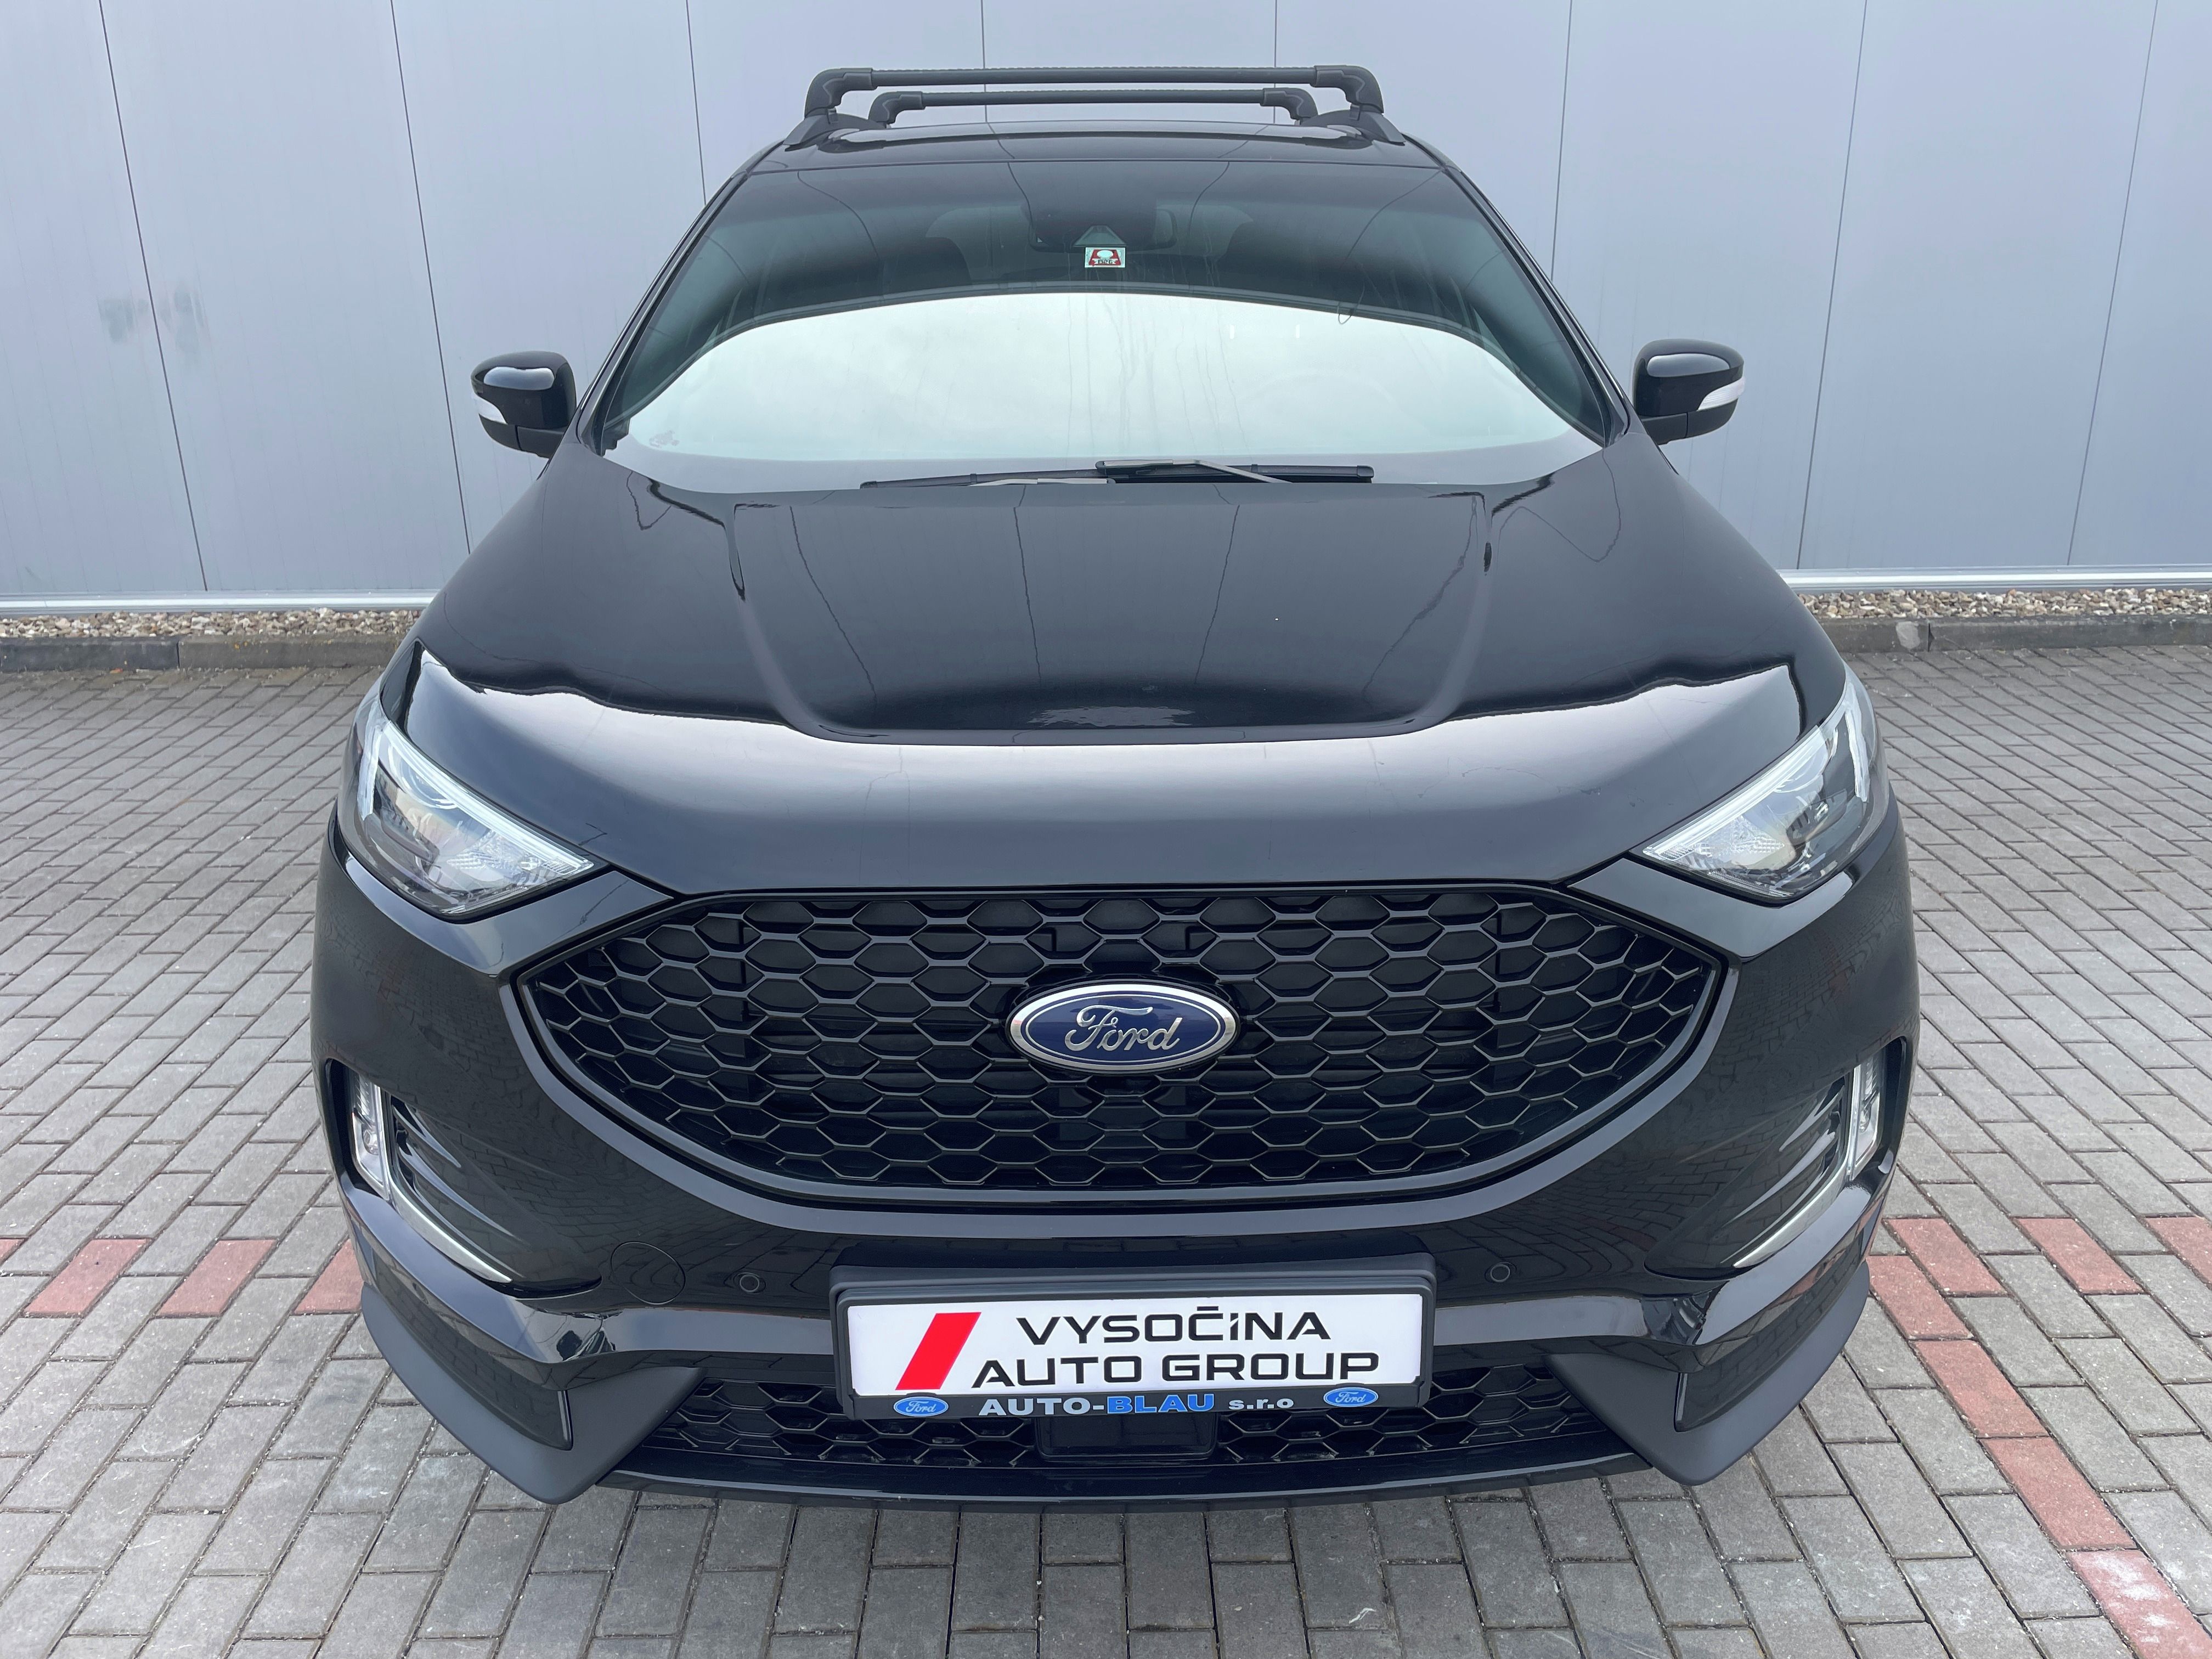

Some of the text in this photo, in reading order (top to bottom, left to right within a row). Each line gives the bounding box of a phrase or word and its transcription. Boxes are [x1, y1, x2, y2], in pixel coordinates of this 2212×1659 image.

[1064, 1005, 1183, 1052] Ford
[971, 1352, 1379, 1389] AUTO GROUP
[906, 1401, 936, 1413] Ford
[979, 1394, 1294, 1415] AUTO-BLAU s.r.o
[1335, 1391, 1367, 1403] Ford
